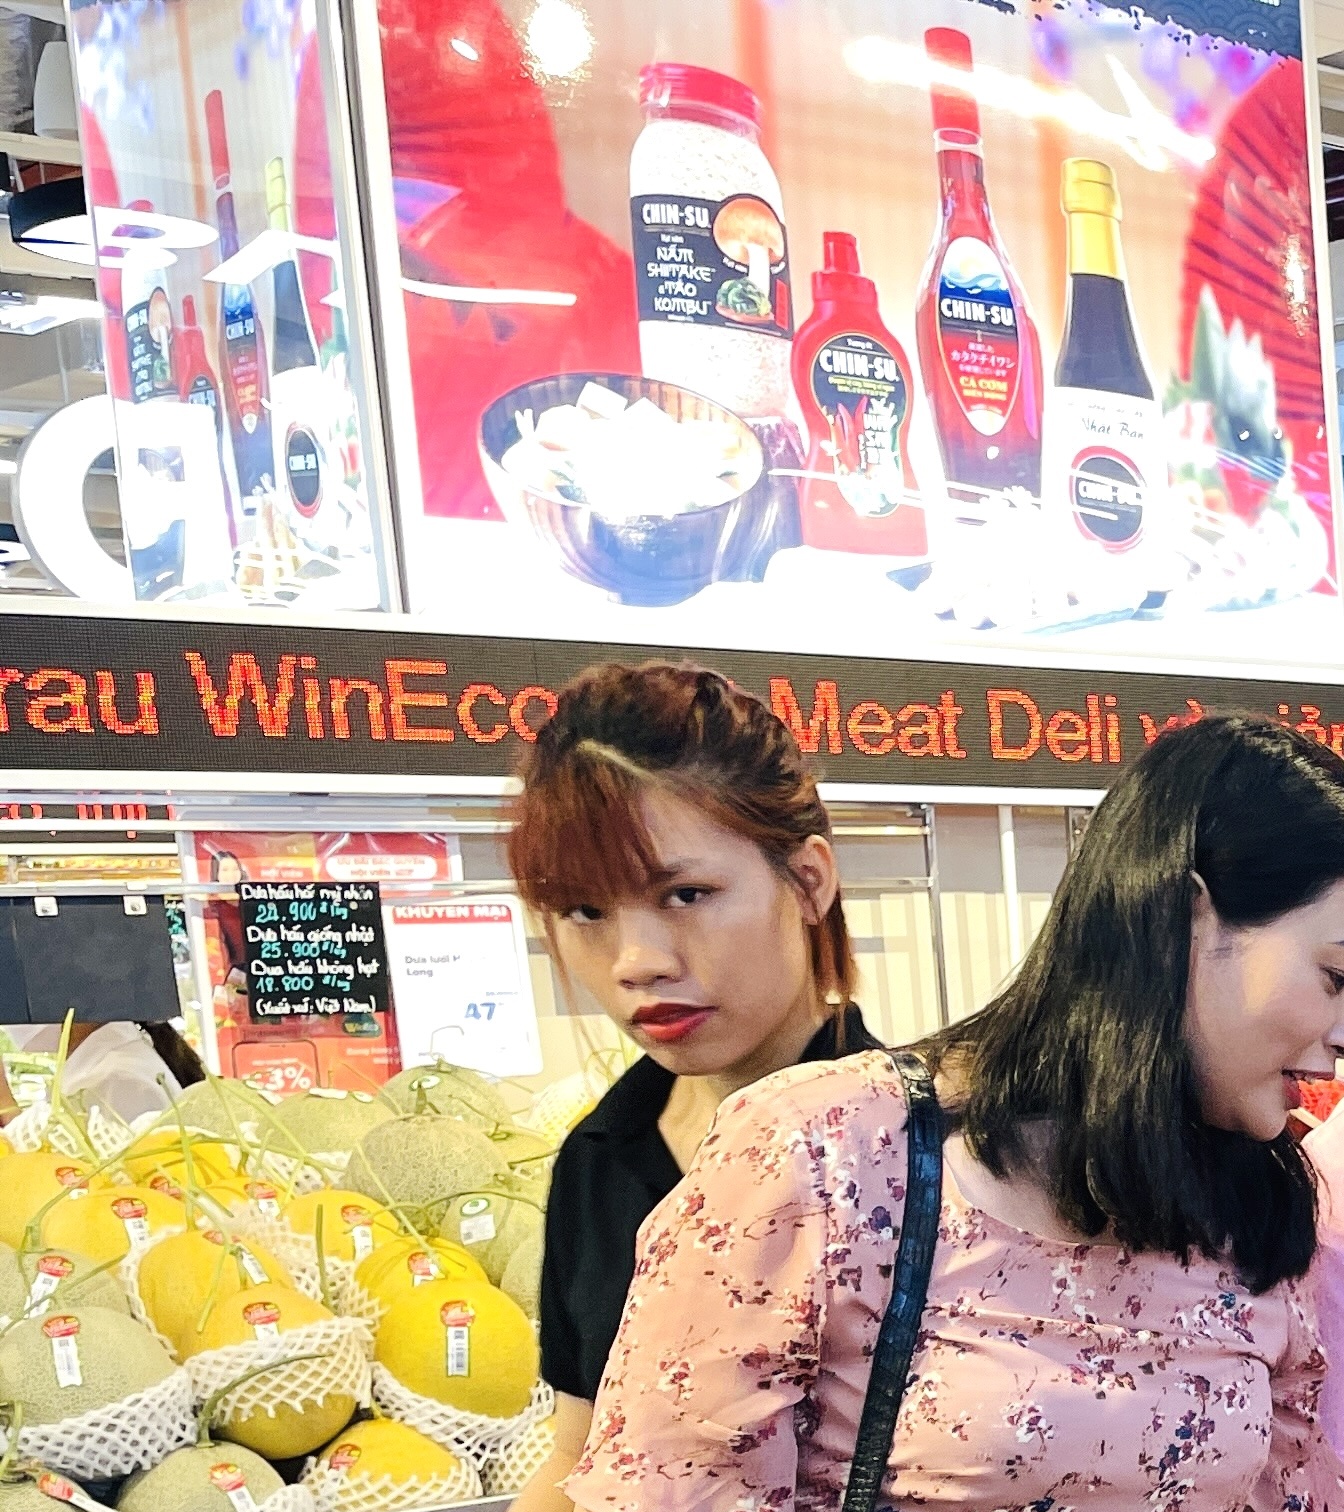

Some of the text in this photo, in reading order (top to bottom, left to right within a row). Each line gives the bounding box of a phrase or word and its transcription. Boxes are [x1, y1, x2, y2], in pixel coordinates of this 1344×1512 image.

[642, 203, 710, 228] CHIN-SU
[940, 298, 1015, 326] CHIN-SU
[819, 349, 899, 382] CHIN-SU
[0, 667, 160, 735] rau
[183, 651, 559, 743] WinEco
[769, 676, 967, 759] Meat
[986, 687, 1121, 764] Deli
